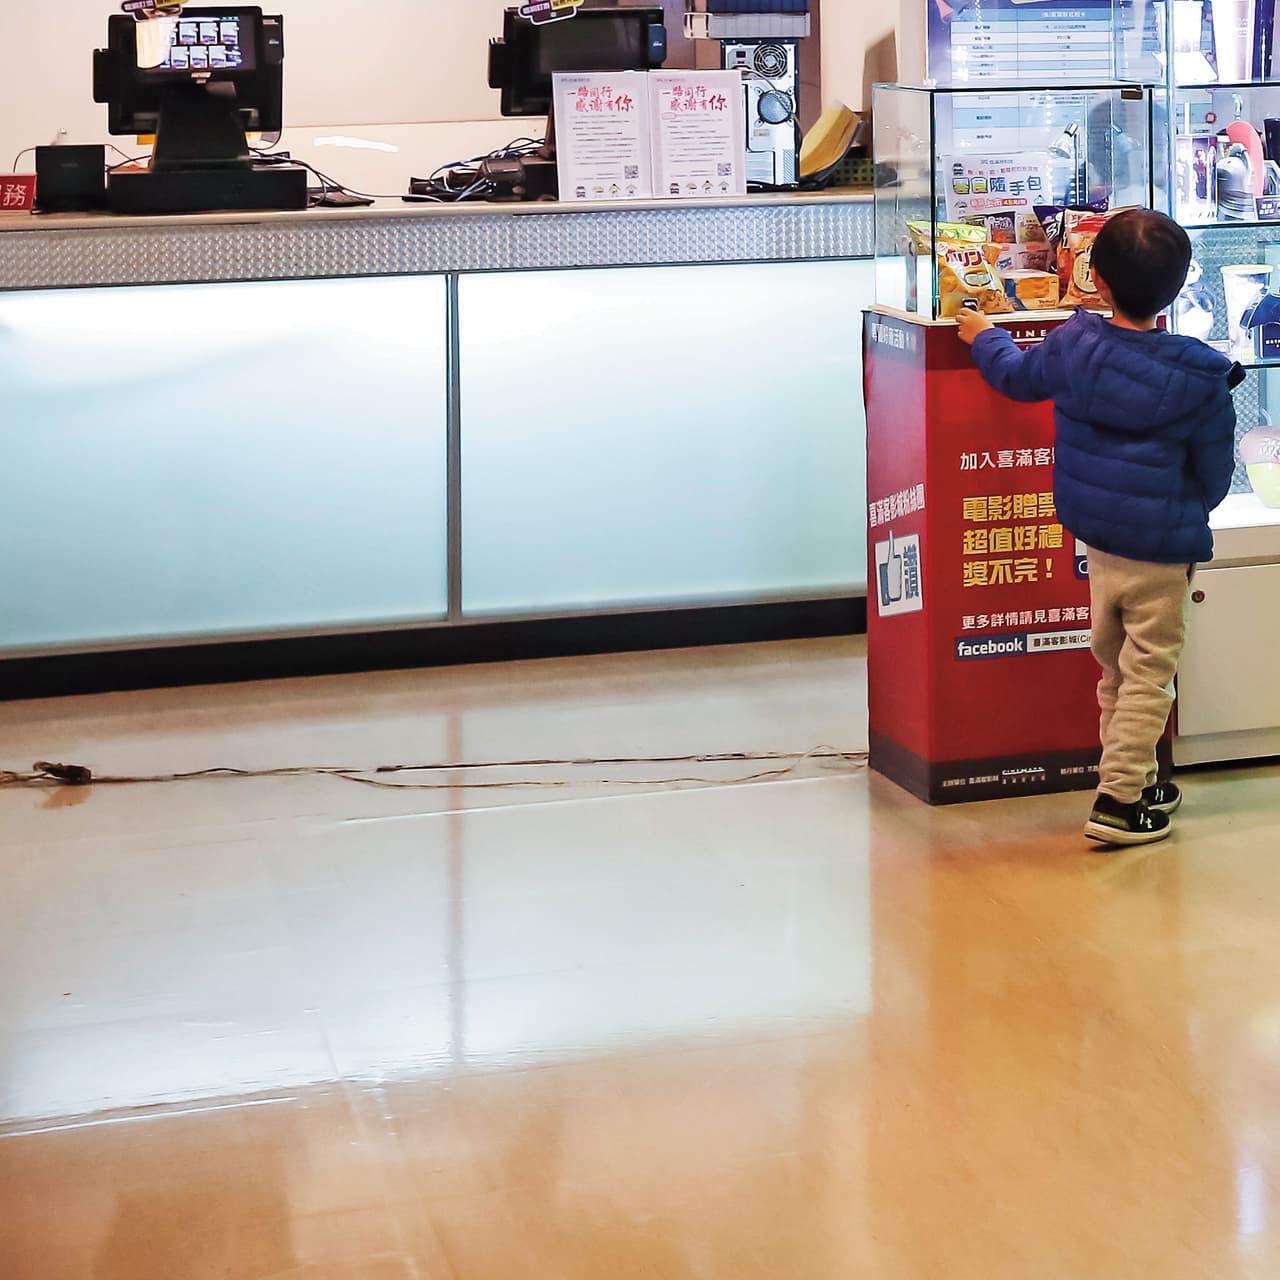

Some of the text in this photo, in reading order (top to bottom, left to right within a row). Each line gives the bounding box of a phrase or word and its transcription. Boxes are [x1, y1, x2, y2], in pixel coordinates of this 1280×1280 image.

[960, 448, 1055, 470] 加入喜滿客
[962, 493, 1056, 522] 電影贈票
[962, 524, 1063, 556] 超值好禮
[963, 558, 1053, 588] 獎不完！
[962, 606, 1090, 630] 更多詳情請見喜滿客
[957, 637, 1024, 657] facebook
